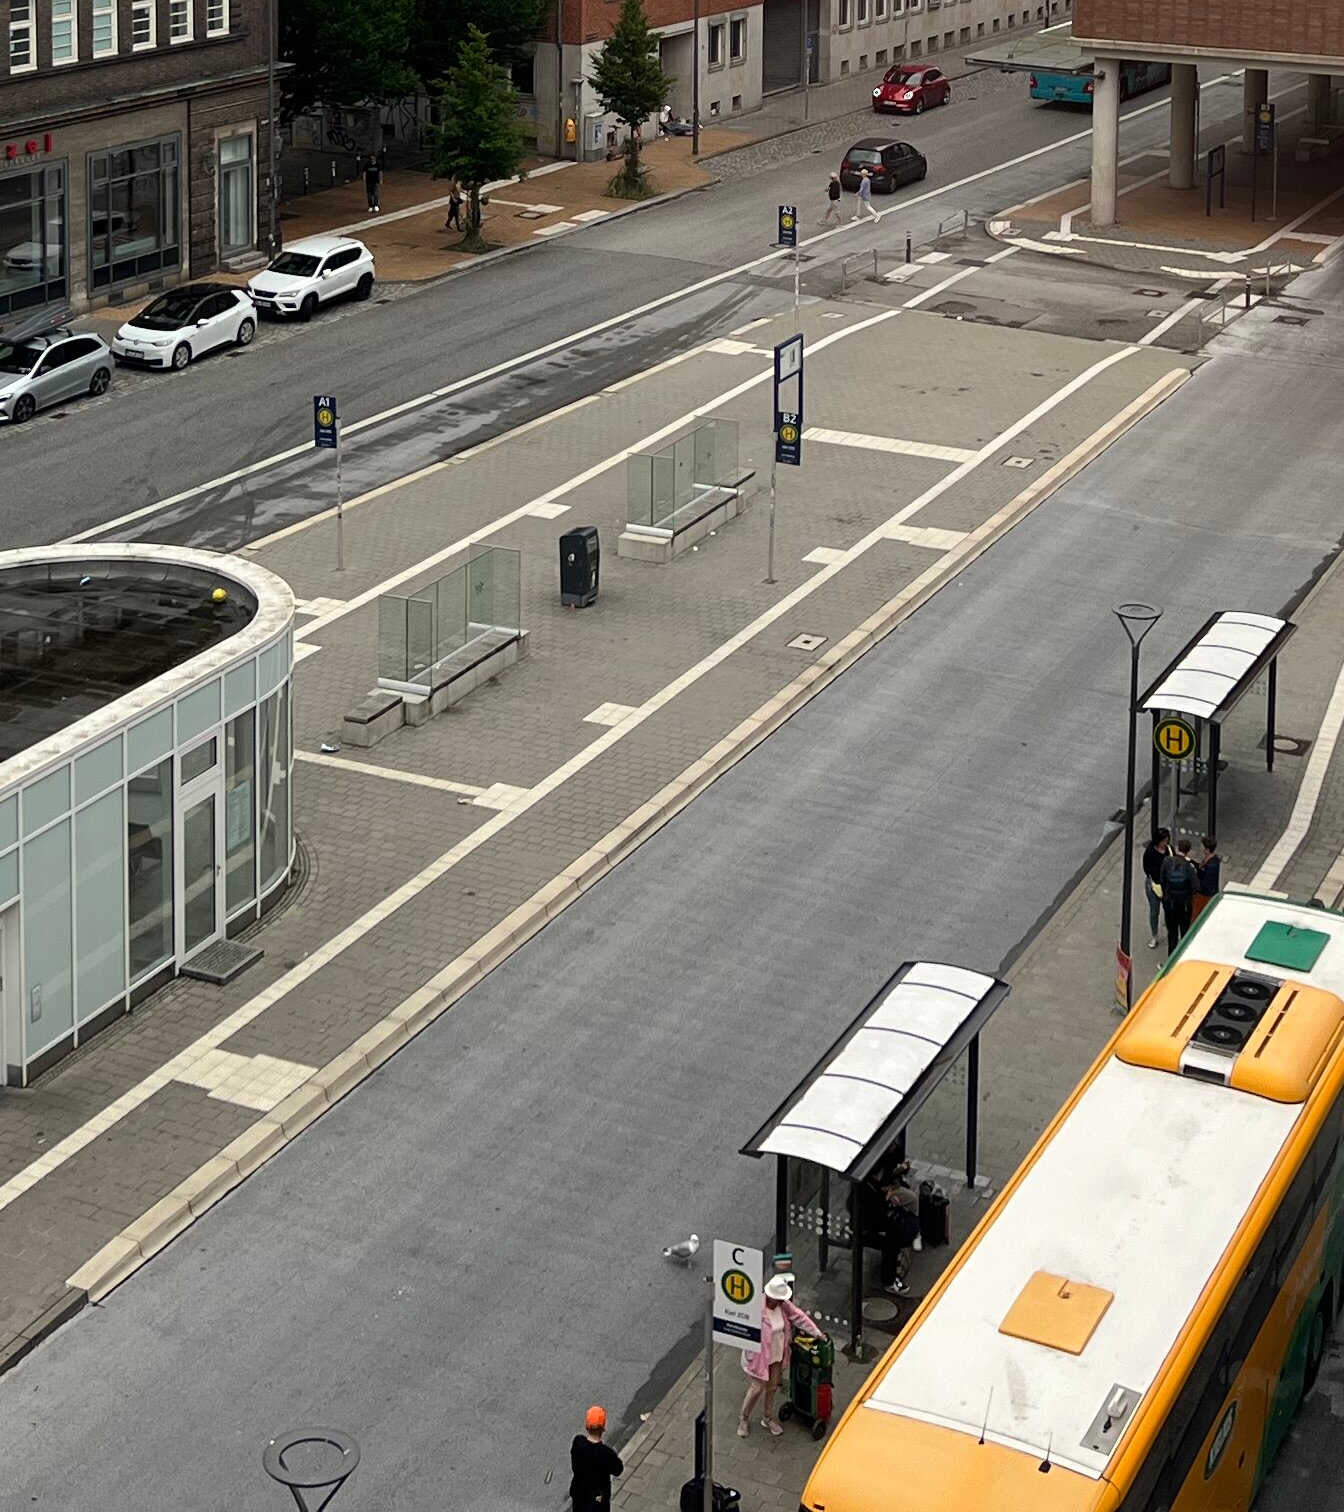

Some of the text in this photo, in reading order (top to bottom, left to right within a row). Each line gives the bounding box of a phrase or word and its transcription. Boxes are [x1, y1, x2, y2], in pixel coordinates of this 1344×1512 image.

[782, 206, 793, 215] A2
[318, 396, 330, 407] A1
[783, 412, 797, 424] B2
[732, 1247, 745, 1266] C
